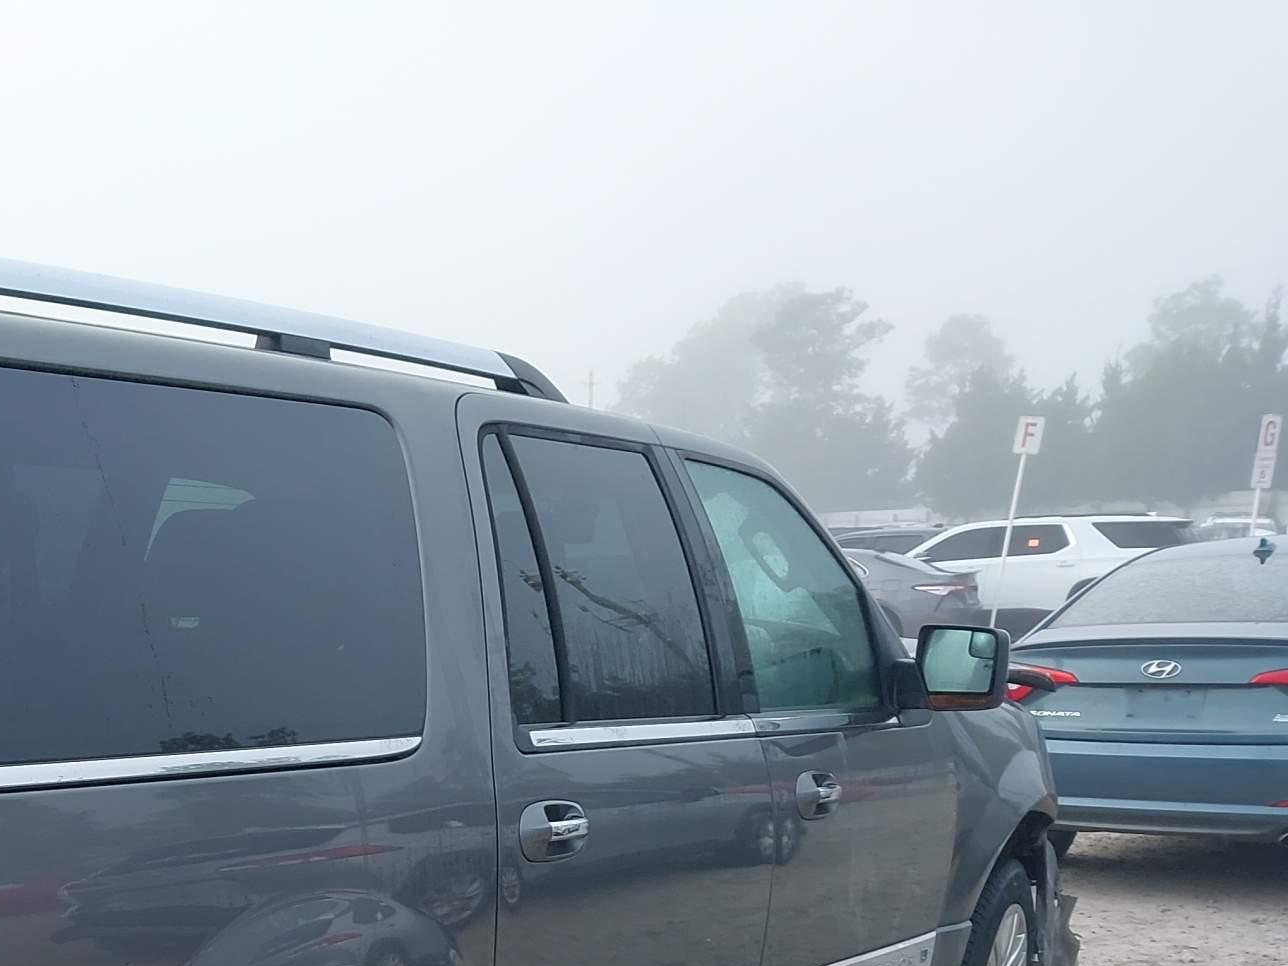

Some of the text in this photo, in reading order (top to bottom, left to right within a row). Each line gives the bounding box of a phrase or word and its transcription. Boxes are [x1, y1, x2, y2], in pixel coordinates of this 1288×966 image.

[1021, 422, 1038, 449] F
[1264, 420, 1278, 446] G
[1029, 710, 1081, 718] SONATA
